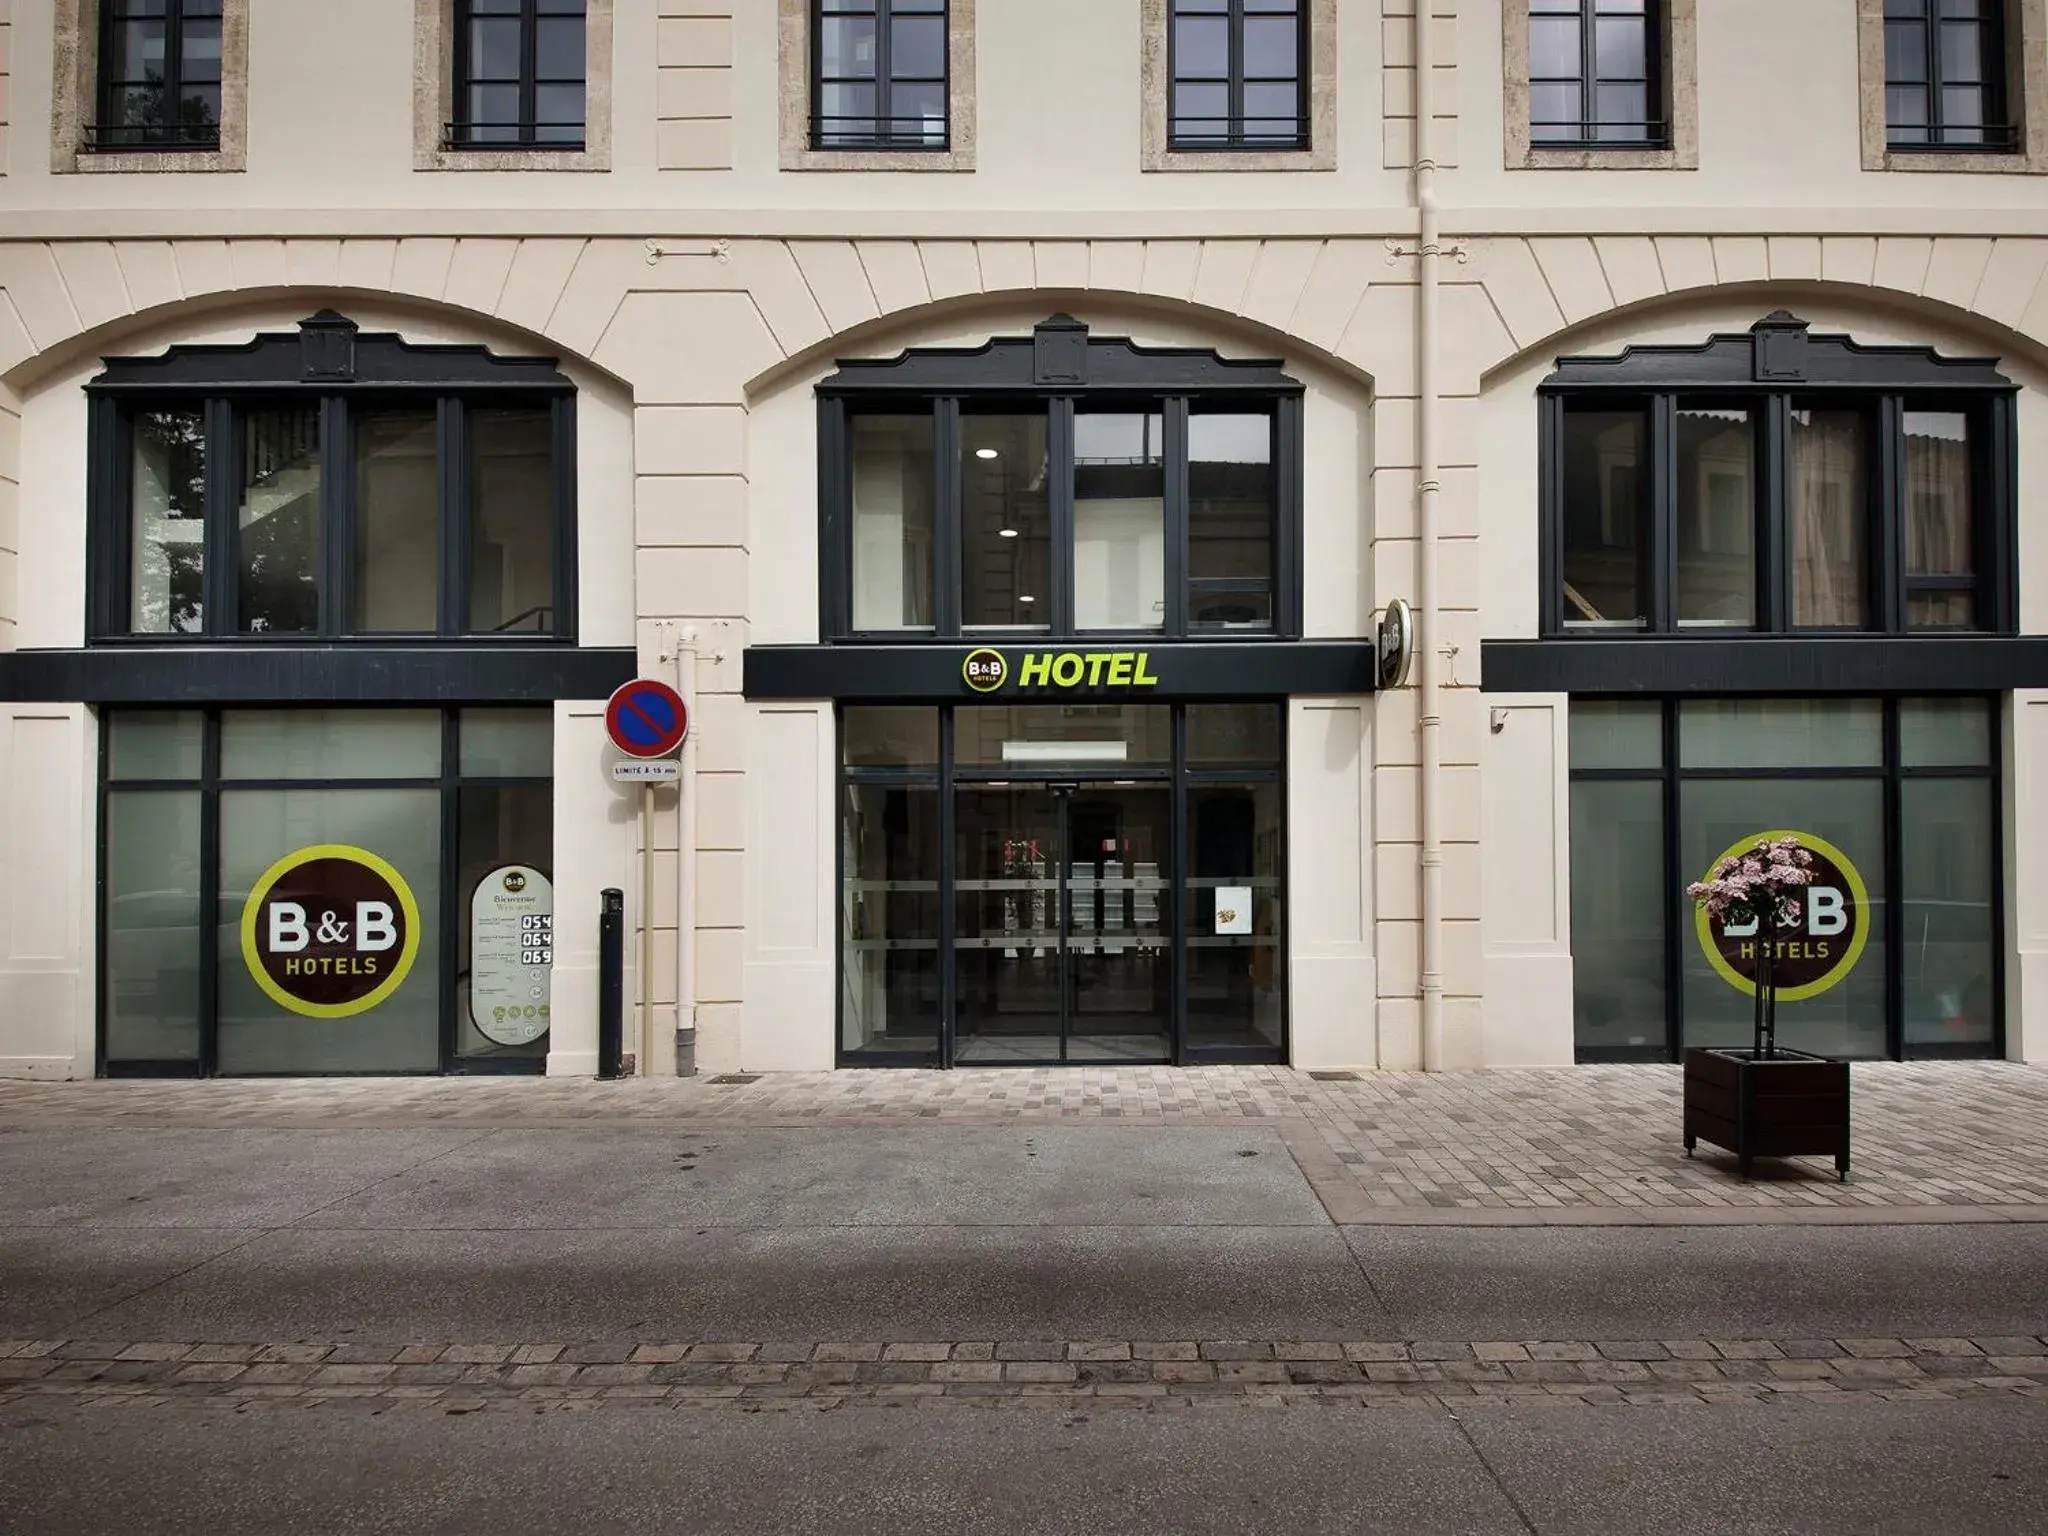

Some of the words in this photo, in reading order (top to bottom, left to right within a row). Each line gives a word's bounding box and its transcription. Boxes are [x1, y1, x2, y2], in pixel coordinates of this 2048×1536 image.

[968, 661, 1001, 676] B&B
[1019, 652, 1158, 687] HOTEL
[505, 877, 524, 886] B&B
[269, 901, 397, 953] B&B
[522, 915, 551, 929] 054
[522, 933, 551, 946] 064
[522, 951, 551, 964] 069
[286, 957, 378, 975] HOTELS
